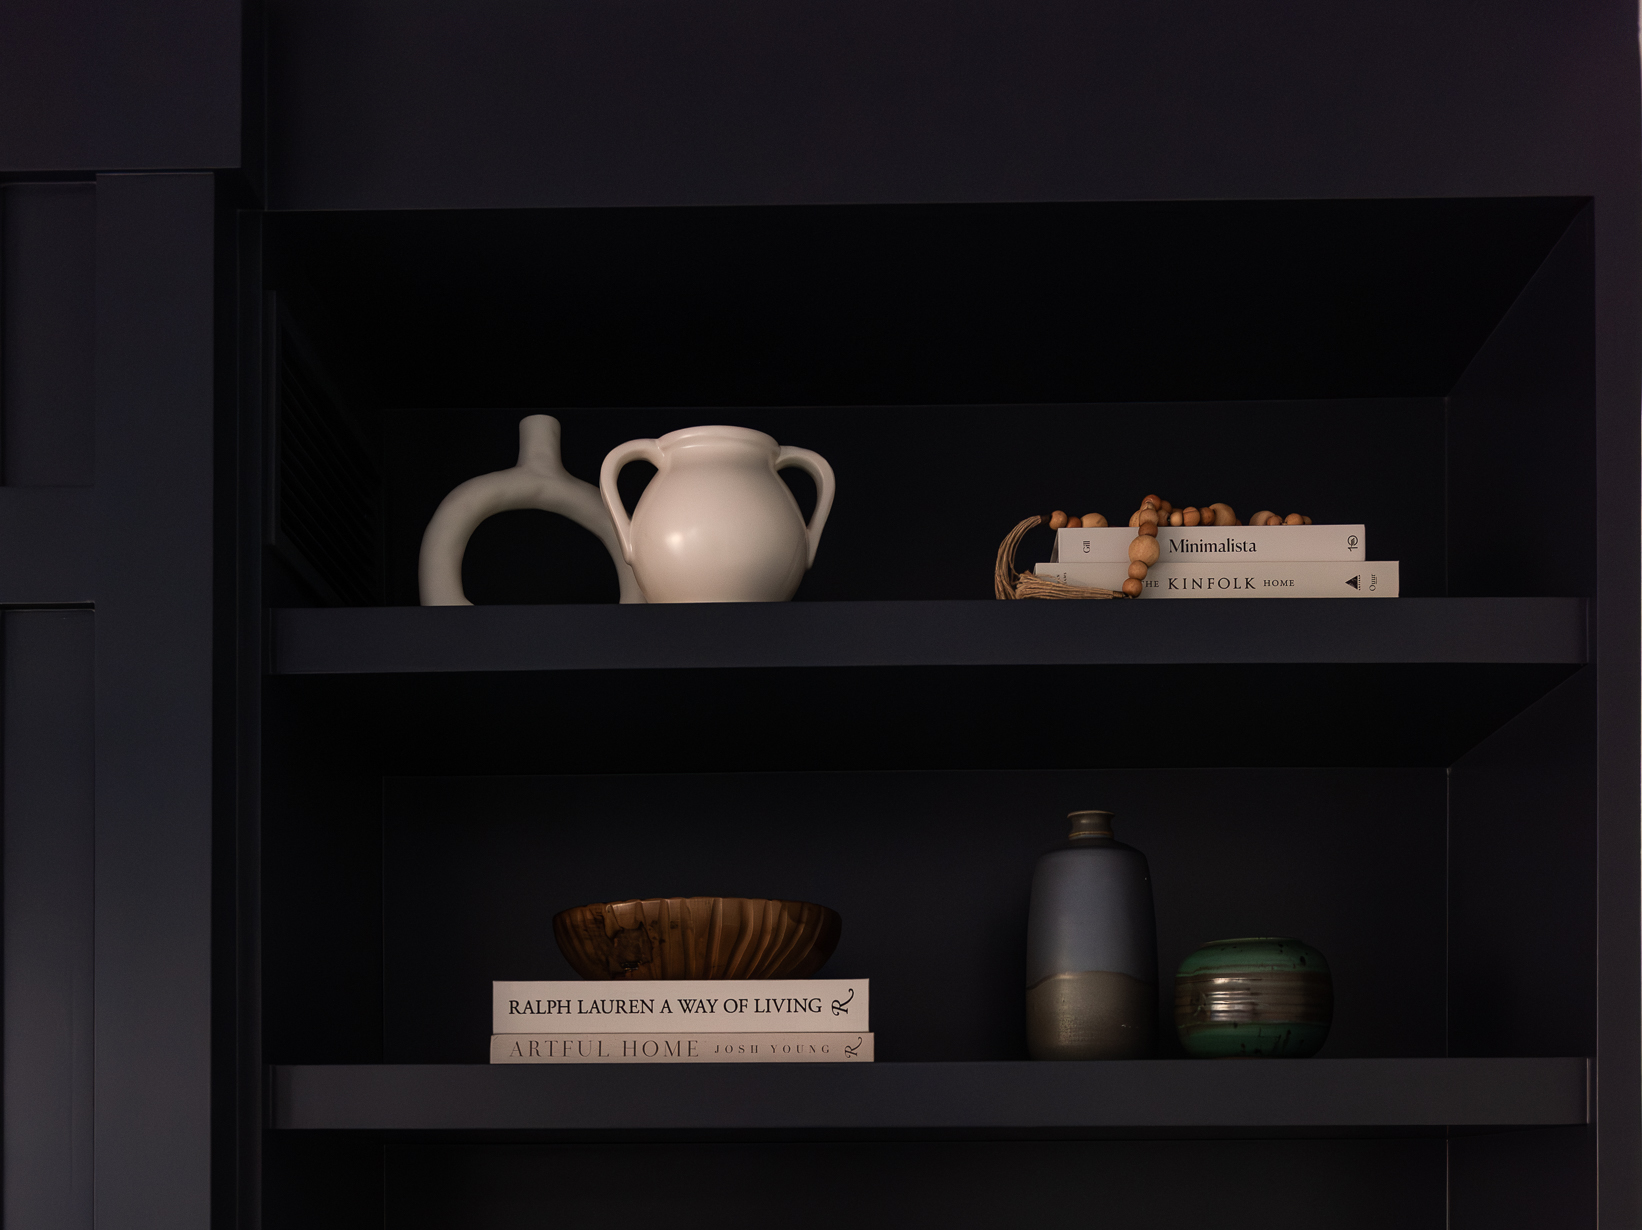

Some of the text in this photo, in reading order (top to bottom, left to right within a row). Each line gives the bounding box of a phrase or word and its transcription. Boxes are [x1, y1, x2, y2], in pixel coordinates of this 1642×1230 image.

[1083, 540, 1091, 554] Gill
[1168, 538, 1258, 553] Minimalista
[1142, 577, 1295, 590] HE KINFOLK HOME
[509, 998, 822, 1014] RALPH LAUREN A WAY OF LIVING
[509, 1040, 830, 1058] ARTFUL HOME JOSH YOUNG
